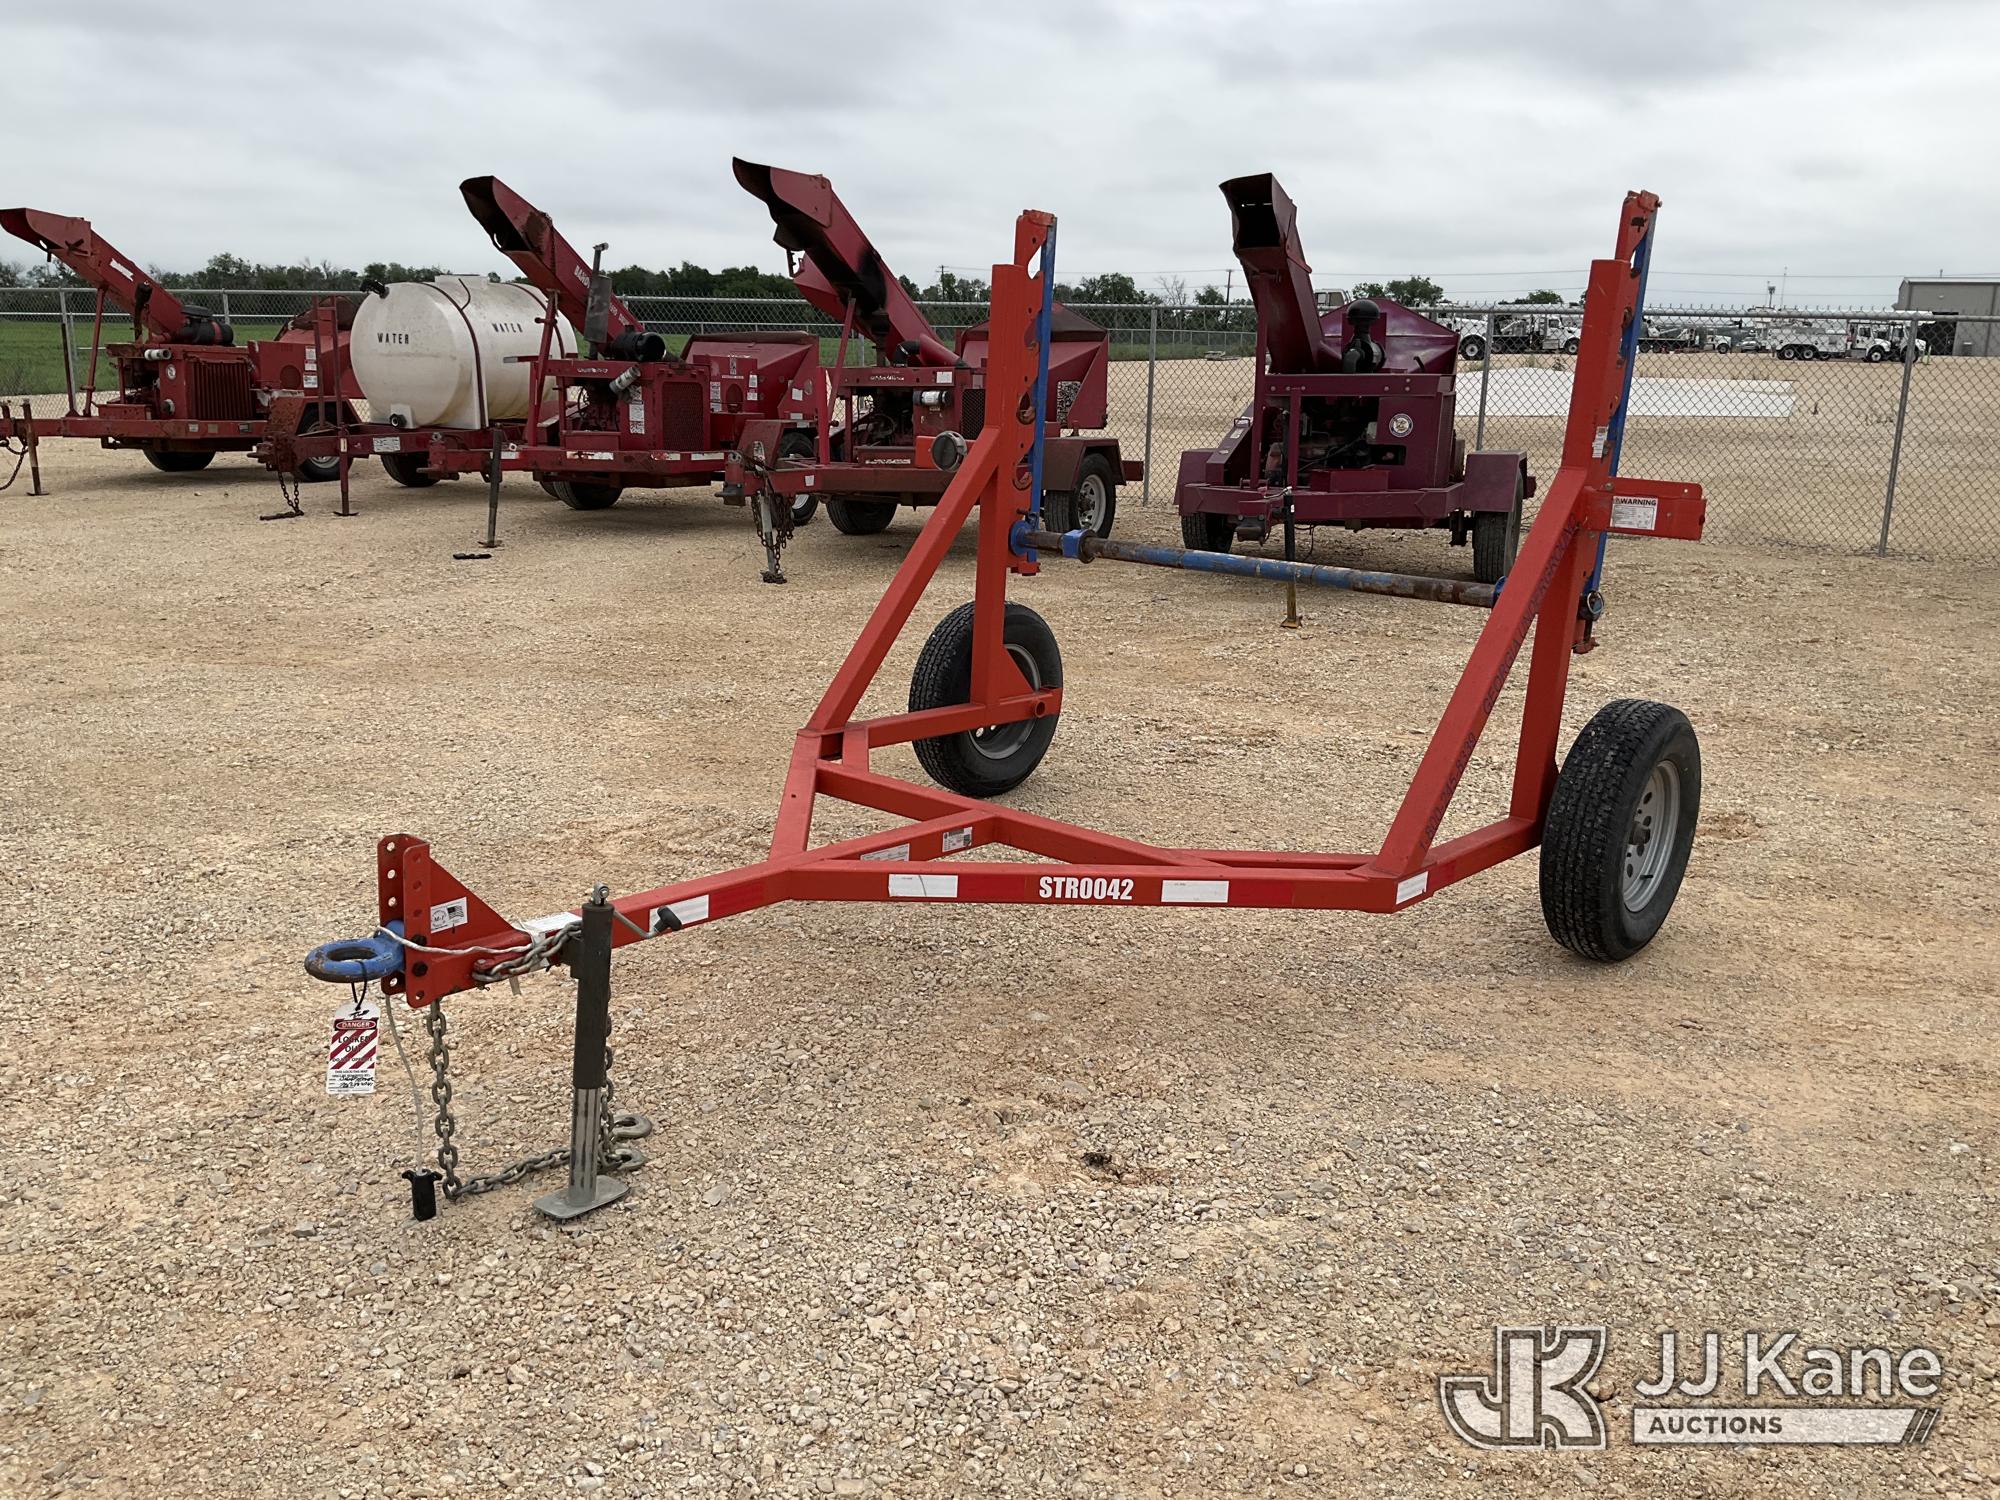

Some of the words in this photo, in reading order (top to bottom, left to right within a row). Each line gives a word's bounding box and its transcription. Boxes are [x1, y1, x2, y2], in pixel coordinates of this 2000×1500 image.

[492, 323, 523, 333] WATER
[377, 333, 409, 344] WATER
[1620, 498, 1657, 506] WARNING
[1039, 876, 1134, 900] STR0042
[338, 1035, 370, 1043] LOCKED
